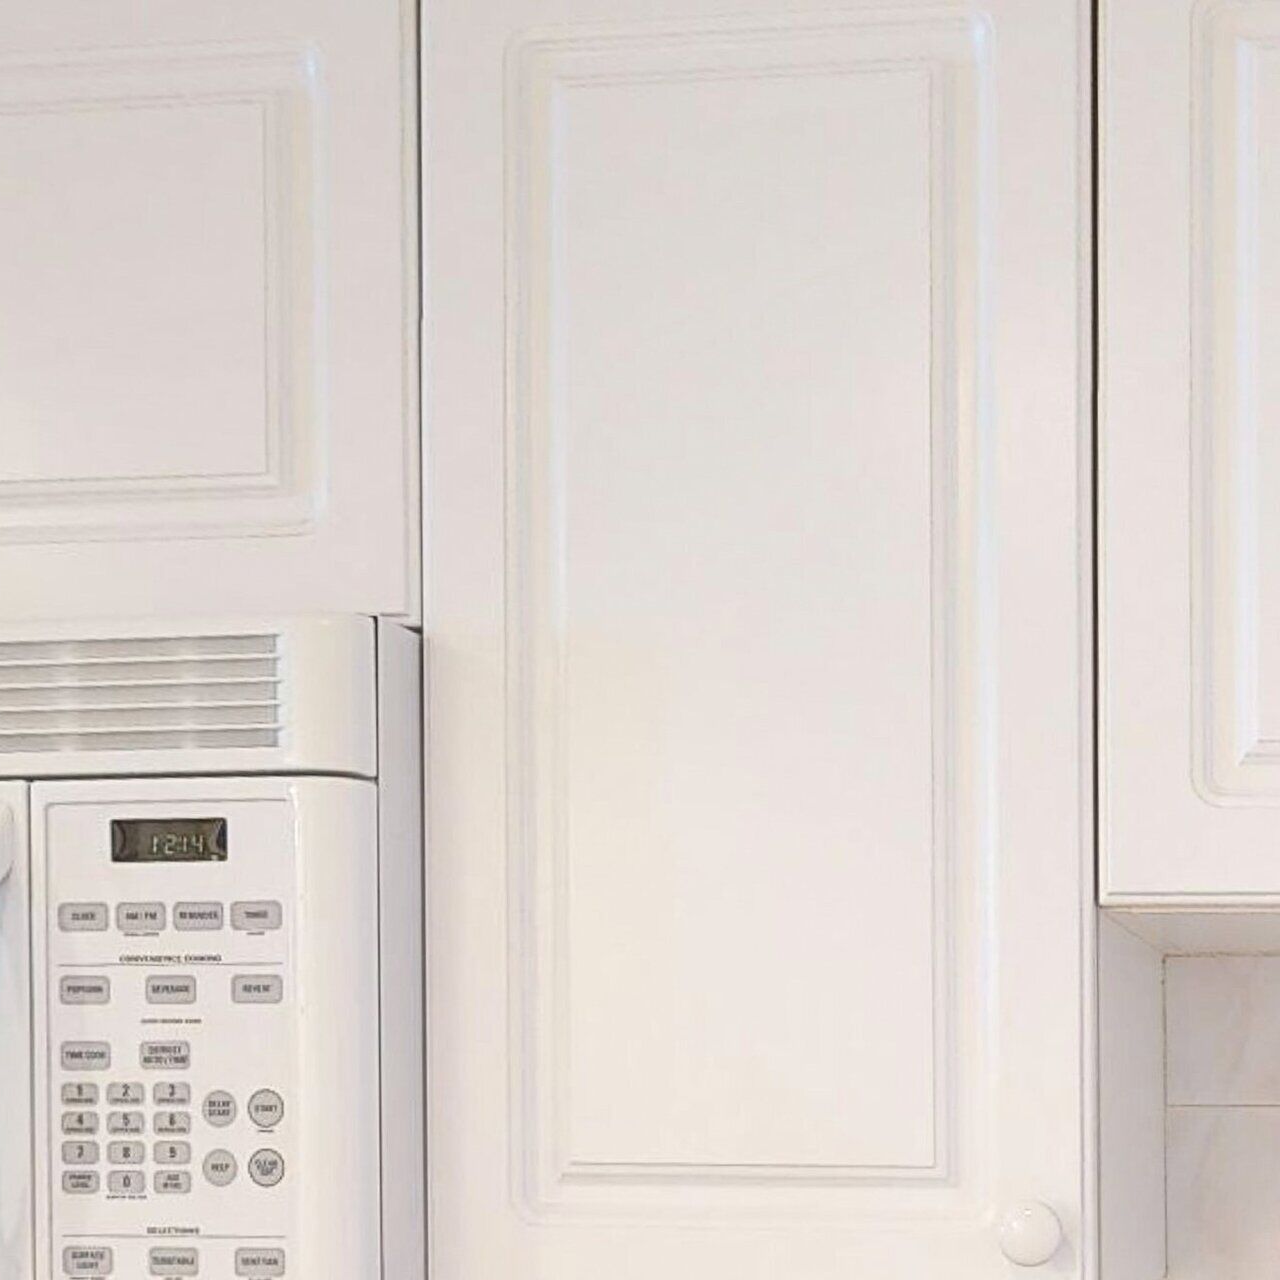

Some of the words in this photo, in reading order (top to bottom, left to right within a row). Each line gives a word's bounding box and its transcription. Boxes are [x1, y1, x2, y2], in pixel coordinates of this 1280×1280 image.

[121, 1083, 130, 1097] 2
[168, 1083, 175, 1097] 3
[76, 1113, 84, 1125] 4
[122, 1113, 130, 1126] 5
[169, 1113, 176, 1126] 6
[77, 1145, 84, 1158] 7
[122, 1146, 131, 1158] 8
[169, 1146, 177, 1158] 9
[122, 1175, 131, 1188] 0
